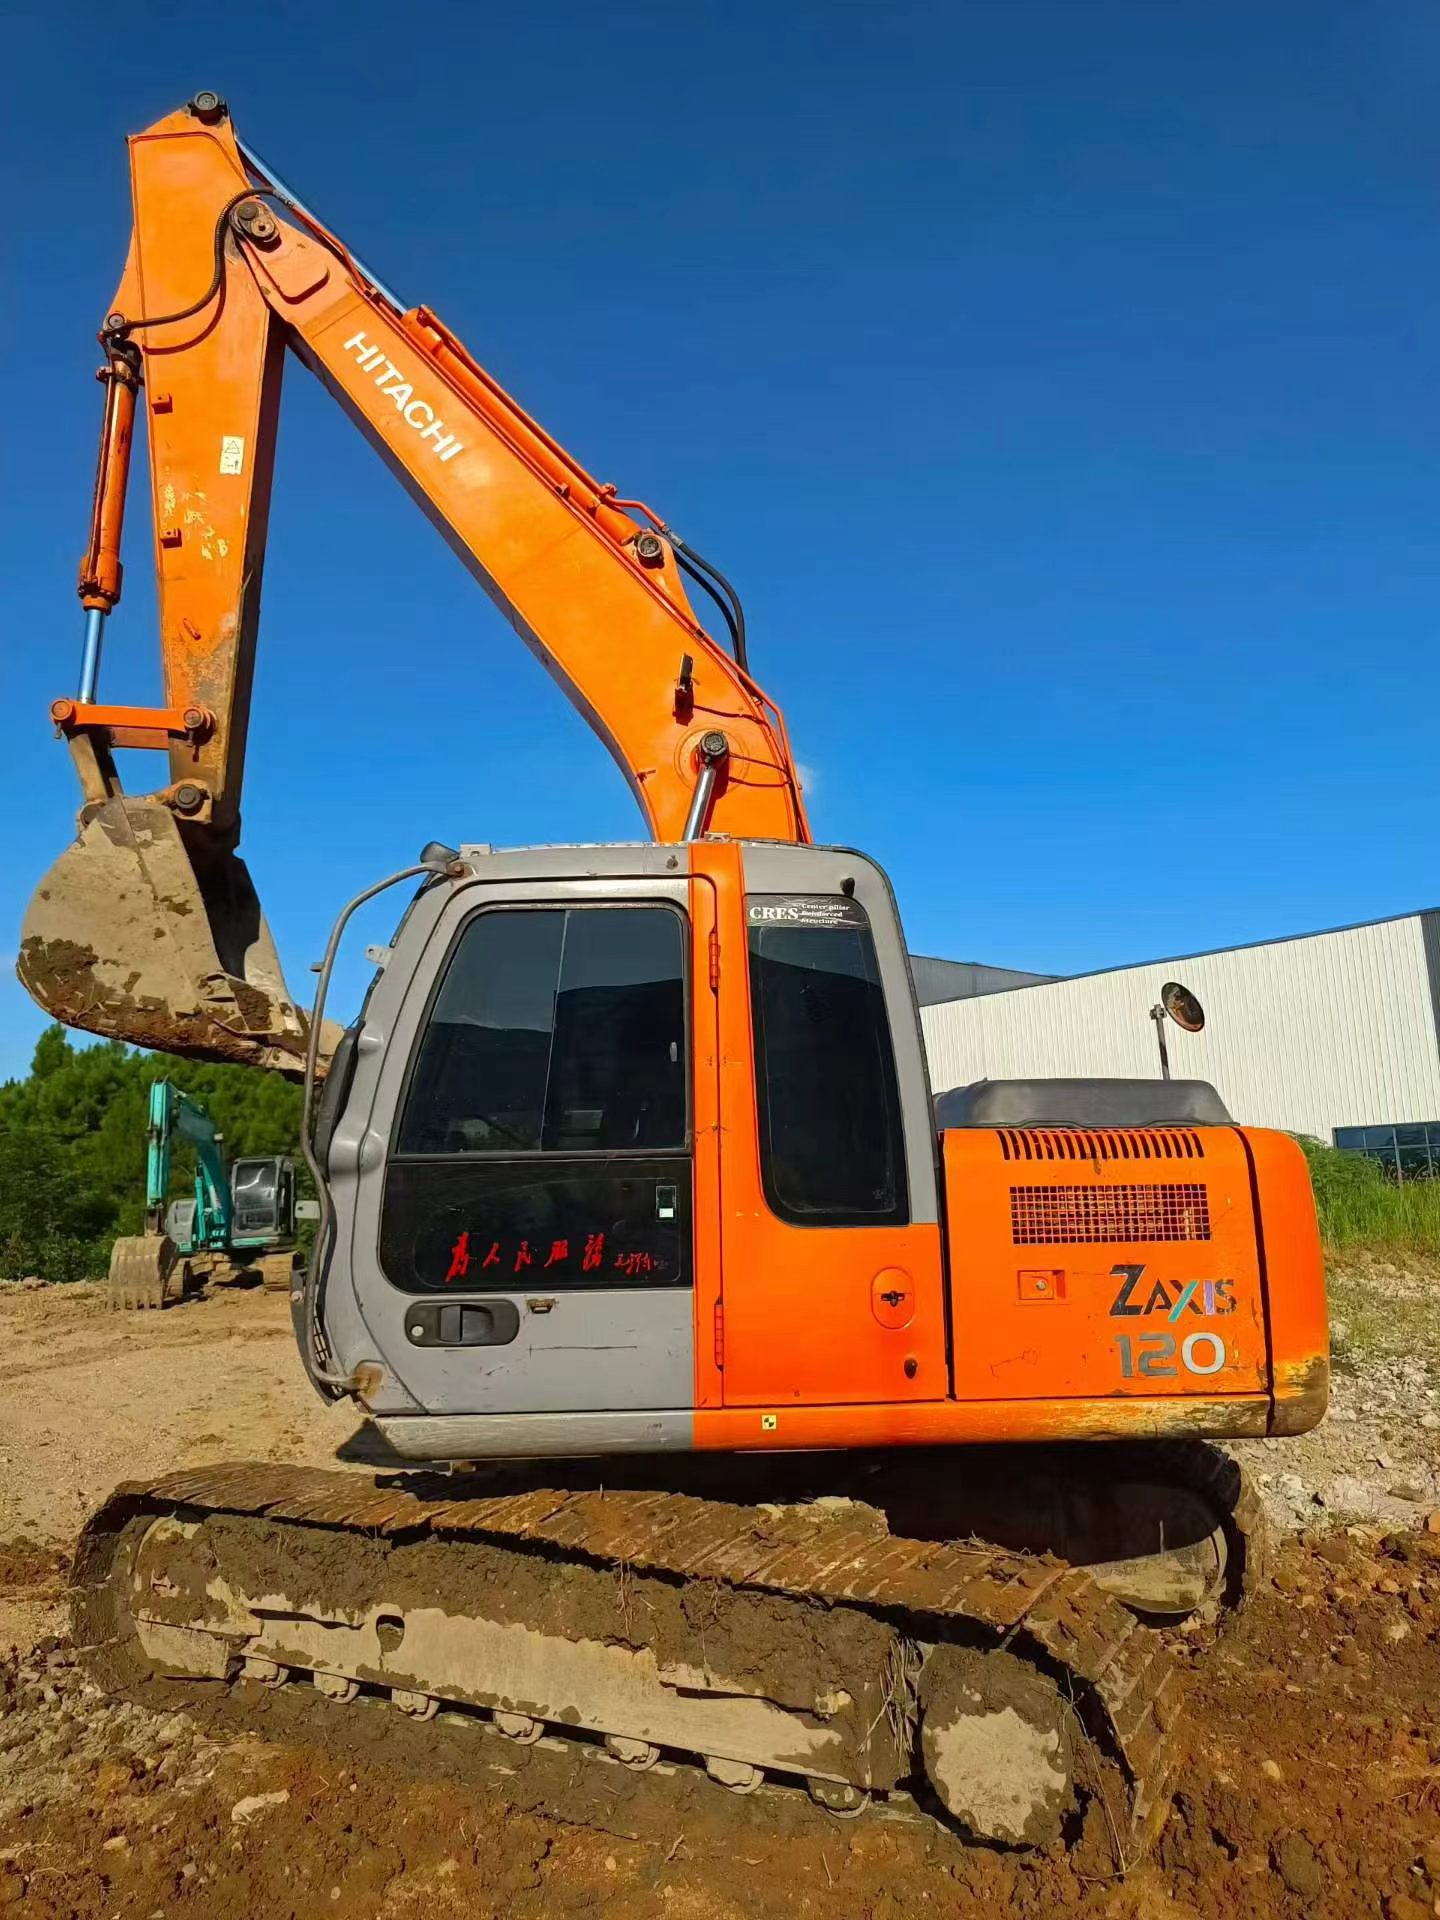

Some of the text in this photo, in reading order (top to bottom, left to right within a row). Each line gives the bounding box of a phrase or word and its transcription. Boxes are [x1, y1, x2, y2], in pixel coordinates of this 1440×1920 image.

[343, 331, 464, 462] HITACHI
[749, 906, 799, 920] CRES
[1109, 1264, 1238, 1322] ZAXIS
[1114, 1332, 1226, 1378] 120
